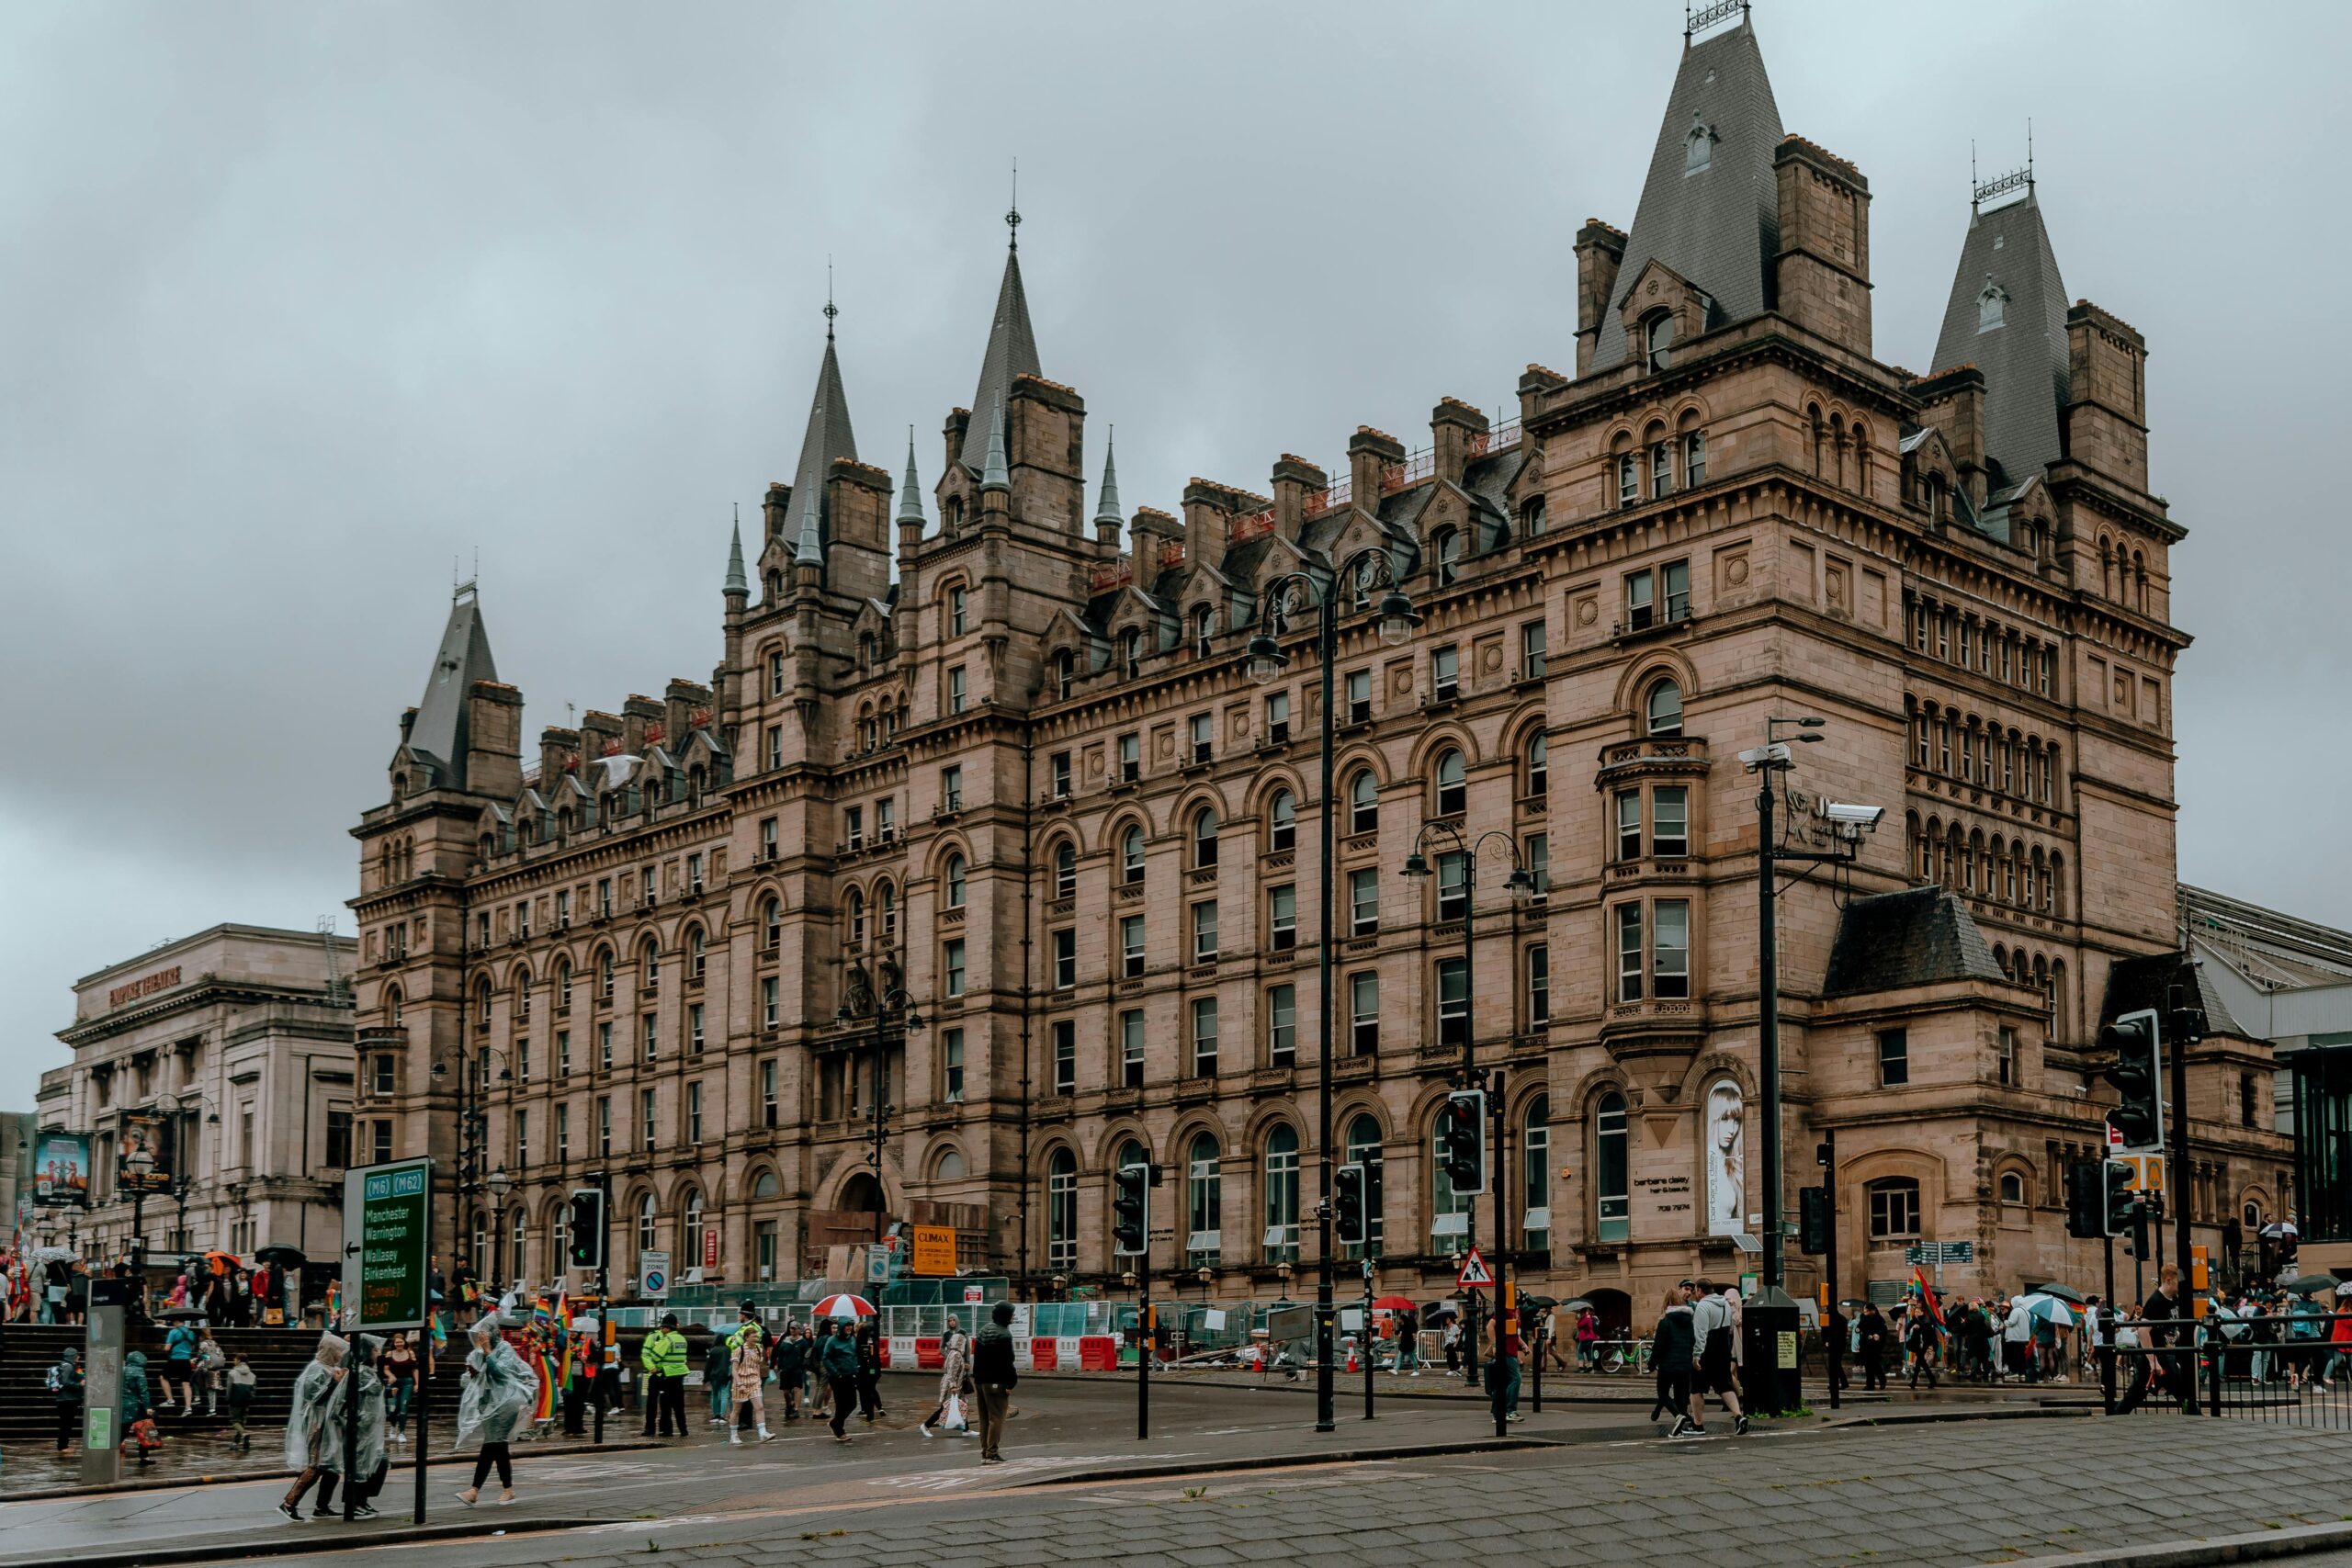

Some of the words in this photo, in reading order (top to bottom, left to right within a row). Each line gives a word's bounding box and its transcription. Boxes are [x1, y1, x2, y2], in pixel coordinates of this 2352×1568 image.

[109, 980, 141, 1007] EMPIRE
[142, 966, 181, 996] THEATRE
[142, 1172, 170, 1181] orse
[368, 1178, 390, 1196] (M6)
[395, 1173, 423, 1193] (M62)
[366, 1208, 410, 1224] Manchester
[365, 1225, 407, 1241] Warrington
[918, 1232, 949, 1243] CLIMAX
[365, 1249, 398, 1264] Wallasey
[364, 1264, 407, 1280] Birkenhead
[364, 1281, 400, 1300] (Tunnels)
